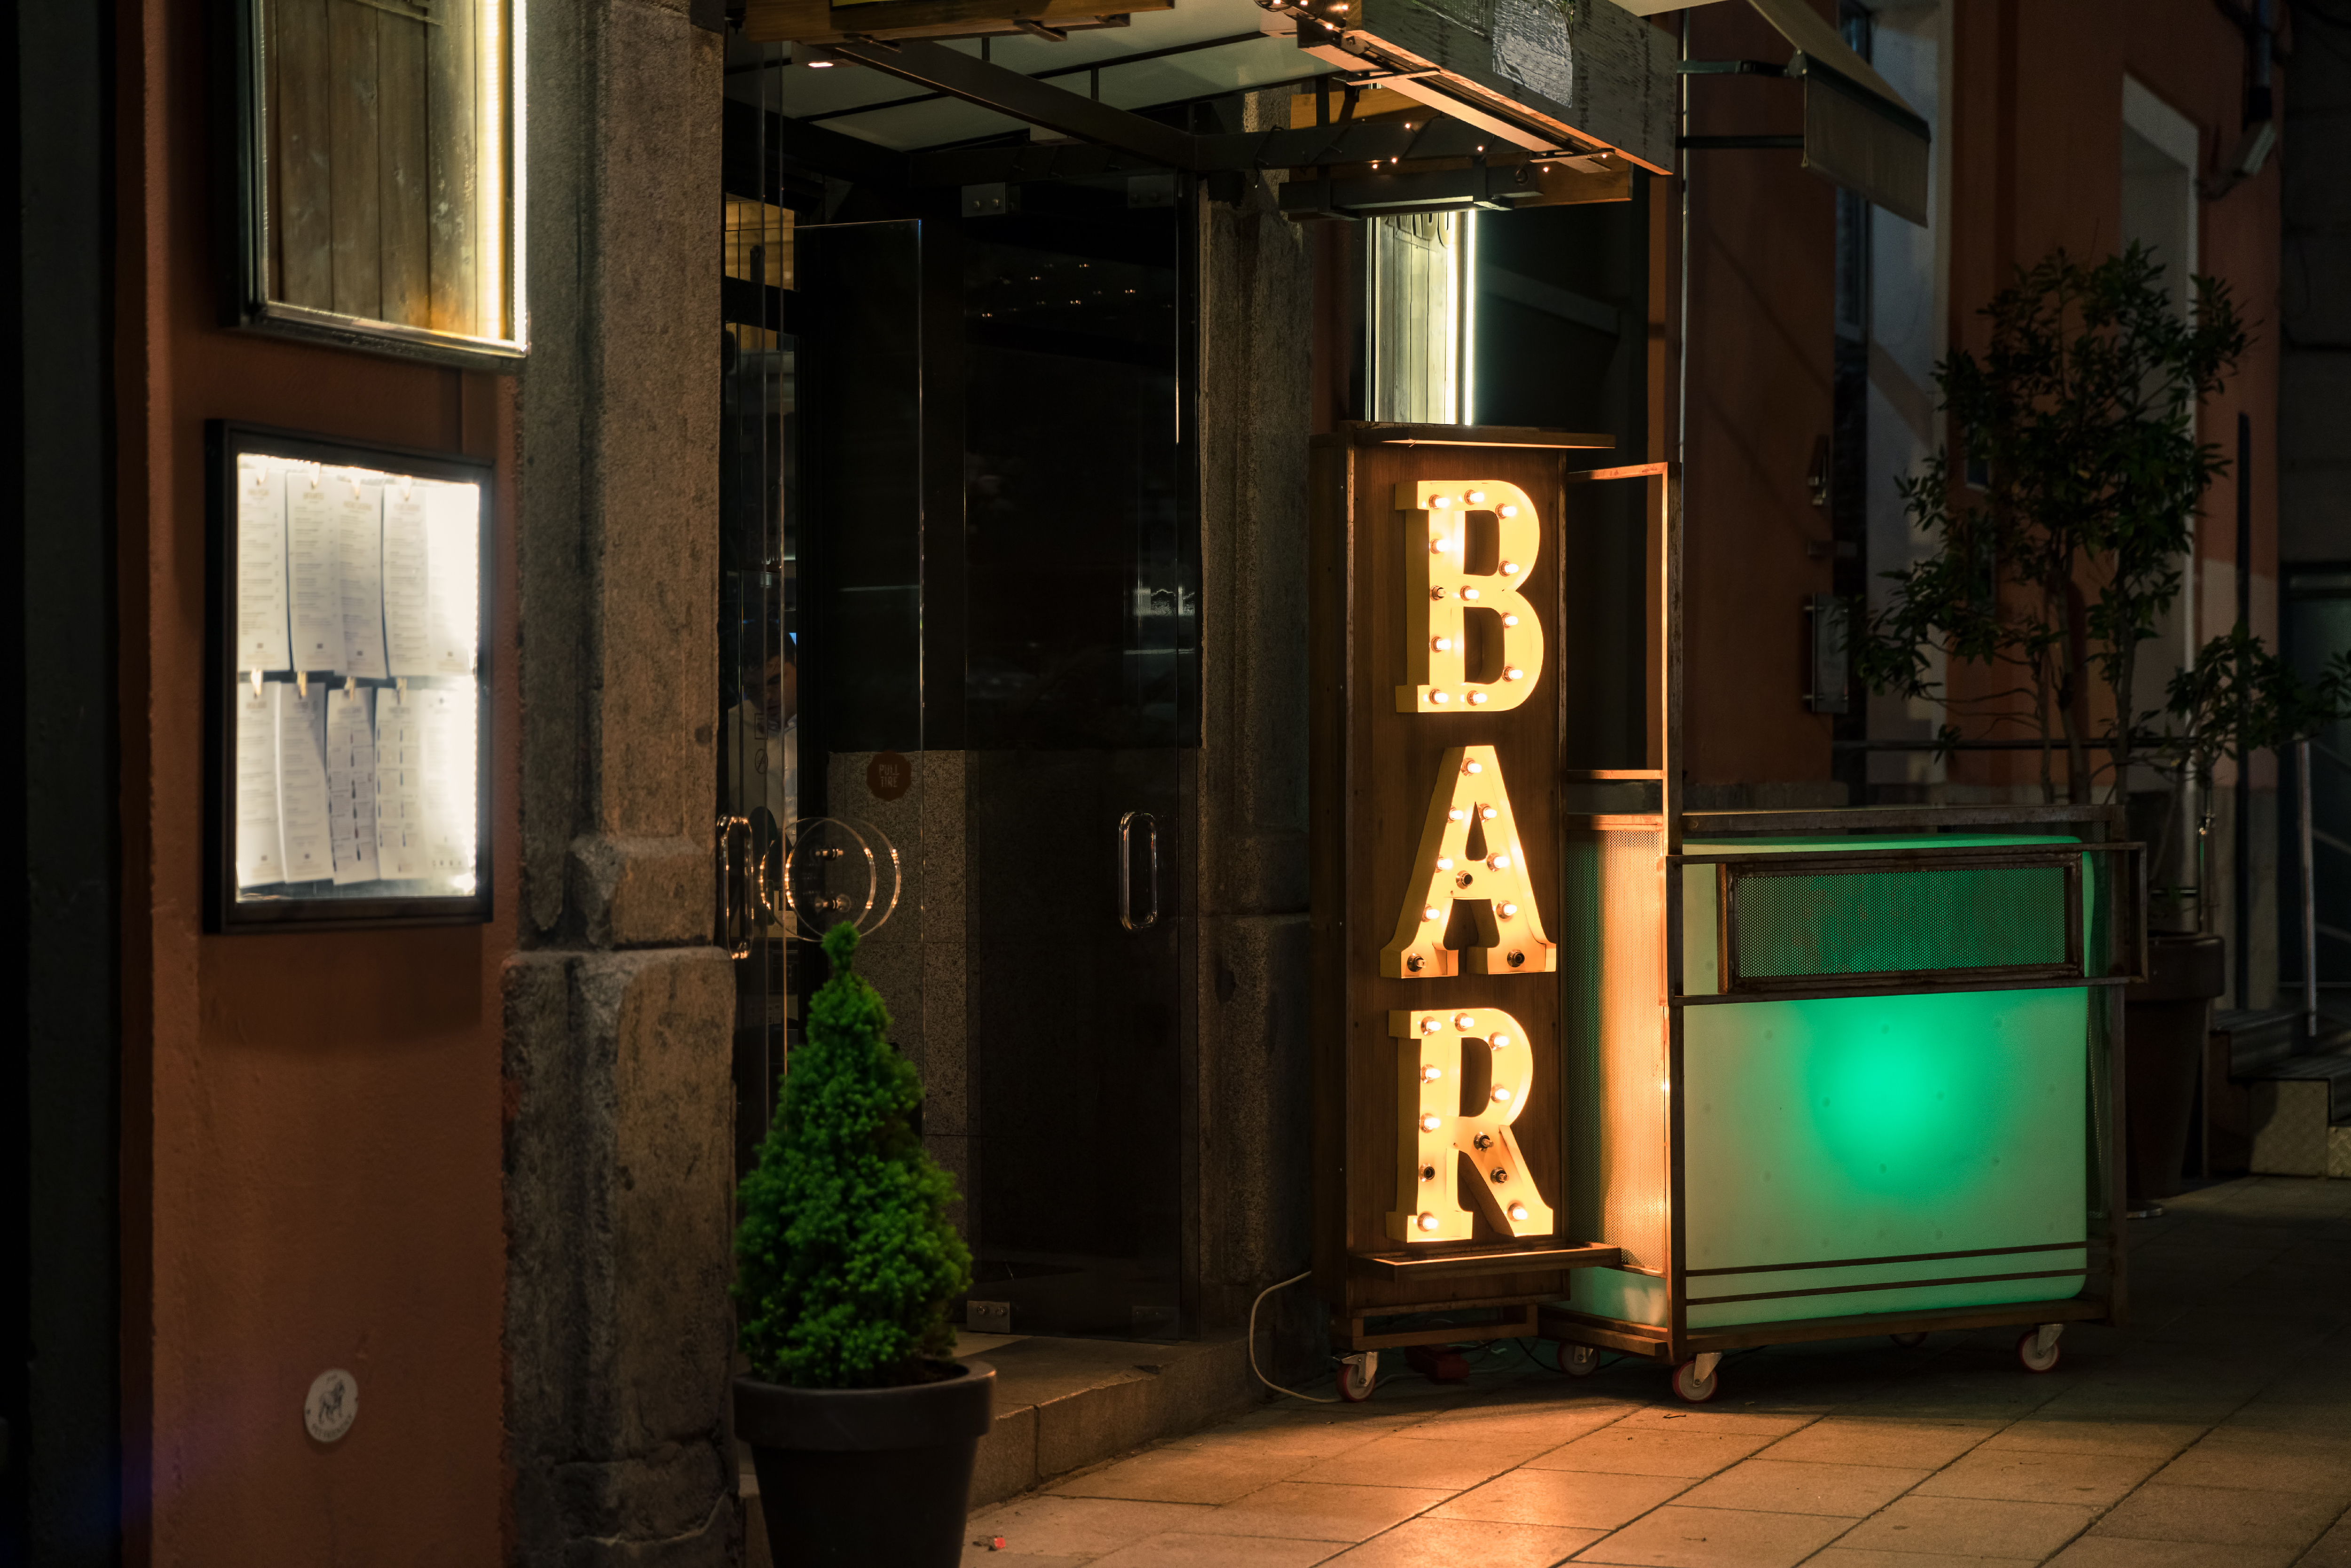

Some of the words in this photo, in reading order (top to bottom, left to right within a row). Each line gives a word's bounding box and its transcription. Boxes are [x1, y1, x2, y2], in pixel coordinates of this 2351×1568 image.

[879, 764, 900, 776] PULL
[880, 776, 898, 788] TIRE
[1380, 480, 1557, 1243] BAR
